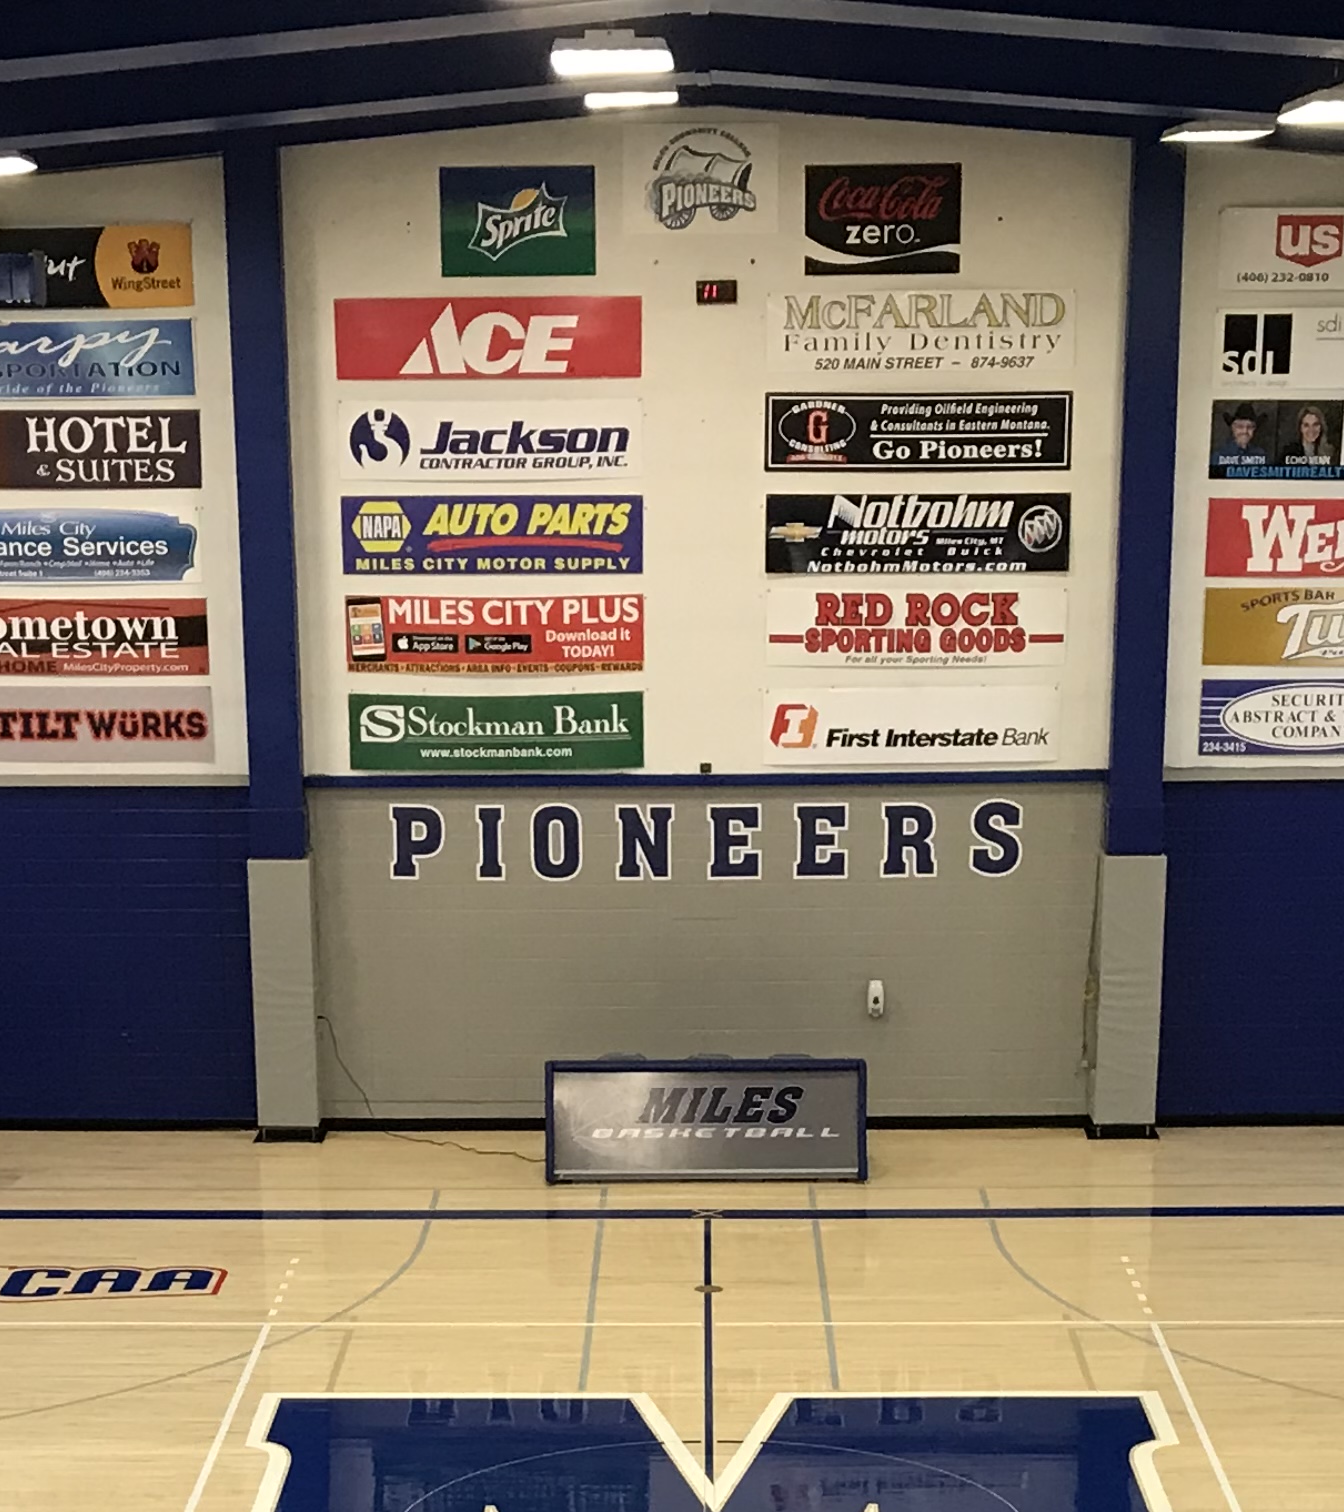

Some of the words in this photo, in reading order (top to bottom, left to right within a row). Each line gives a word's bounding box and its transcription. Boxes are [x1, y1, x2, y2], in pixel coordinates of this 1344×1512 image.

[660, 182, 756, 219] PIONEERS
[482, 201, 556, 249] Sprite
[1279, 224, 1340, 255] us
[111, 278, 180, 291] WingStreet
[399, 303, 579, 375] ACE
[784, 332, 892, 354] Family
[910, 331, 1062, 354] Dentistry
[815, 358, 840, 370] 520
[843, 357, 882, 369] MAIN
[885, 356, 944, 369] STREET
[970, 355, 1034, 368] 874-9637
[881, 404, 931, 416] Providing
[935, 404, 972, 414] Oilfield
[975, 404, 1038, 416] Engineering
[26, 417, 187, 453] HOTEL
[881, 420, 943, 432] Consultants
[959, 420, 997, 430] Eastern
[420, 421, 630, 454] Jackson
[872, 441, 911, 460] Go
[920, 439, 1043, 459] Pioneers!
[56, 459, 175, 482] SUITES
[420, 457, 527, 469] CONTRACTOR
[532, 457, 593, 470] GROUP,
[597, 455, 628, 467] INC.
[423, 504, 518, 535] AUTO
[527, 504, 631, 535] PARTS
[828, 495, 1014, 529] Notbohm
[1, 522, 50, 535] Miles
[59, 521, 96, 538] City
[362, 515, 402, 539] NAPA
[63, 537, 168, 555] Services
[356, 558, 414, 570] MILES
[423, 558, 469, 570] CITY
[477, 558, 545, 570] MOTOR
[554, 557, 630, 570] SUPPLY
[807, 561, 1027, 572] NotbohmMotors.com
[388, 599, 474, 624] MILES
[482, 599, 554, 625] CITY
[563, 597, 639, 624] PLUS
[815, 593, 893, 626] RED
[906, 593, 1018, 626] ROCK
[1241, 590, 1300, 612] SPORTS
[1304, 590, 1335, 600] BAR
[546, 629, 616, 642] Download
[620, 629, 630, 641] it
[805, 628, 931, 653] SPORTING
[940, 627, 1026, 653] GOODS
[52, 642, 179, 658] ESTATE
[562, 645, 614, 658] TODAY!
[408, 706, 544, 736] Stockman
[553, 704, 629, 735] Bank
[1230, 710, 1316, 723] ABSTRACT
[826, 729, 880, 747] First
[885, 729, 998, 747] Interstate
[1002, 728, 1050, 746] Bank
[420, 747, 572, 758] www.stockmanbank.com
[388, 799, 1024, 881] PIONEERS
[636, 1086, 804, 1124] MILES
